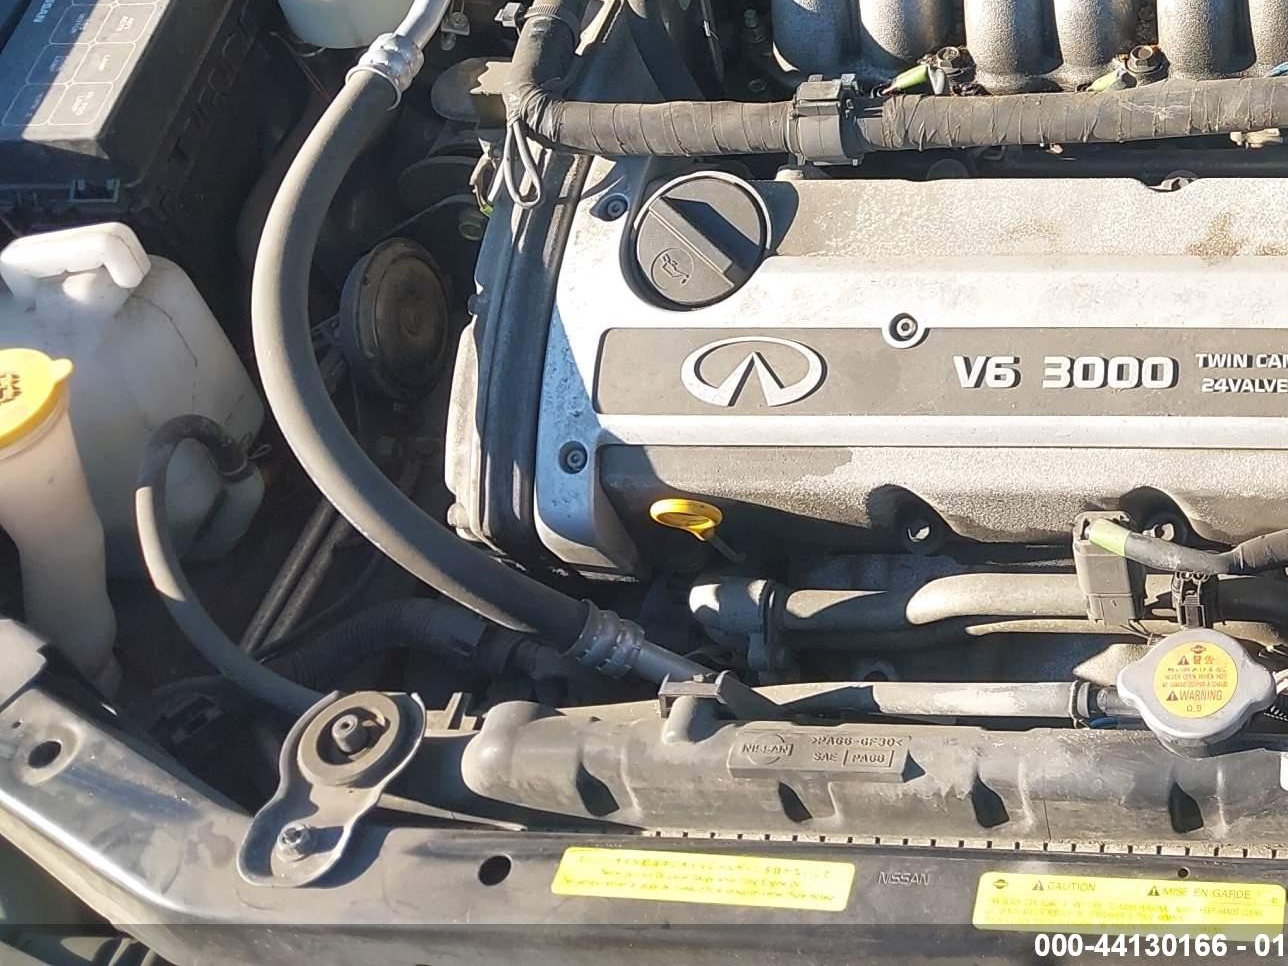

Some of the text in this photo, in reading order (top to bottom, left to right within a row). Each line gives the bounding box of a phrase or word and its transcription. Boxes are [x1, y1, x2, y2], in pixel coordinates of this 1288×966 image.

[952, 355, 1018, 389] V6
[1041, 355, 1178, 389] 3000
[1194, 352, 1251, 369] TWIN
[1180, 689, 1223, 702] WARNING
[741, 743, 789, 755] NISSAN
[879, 871, 931, 886] NISSAN
[1047, 881, 1096, 892] CAUTION
[1163, 887, 1252, 899] MISE EN GARDE
